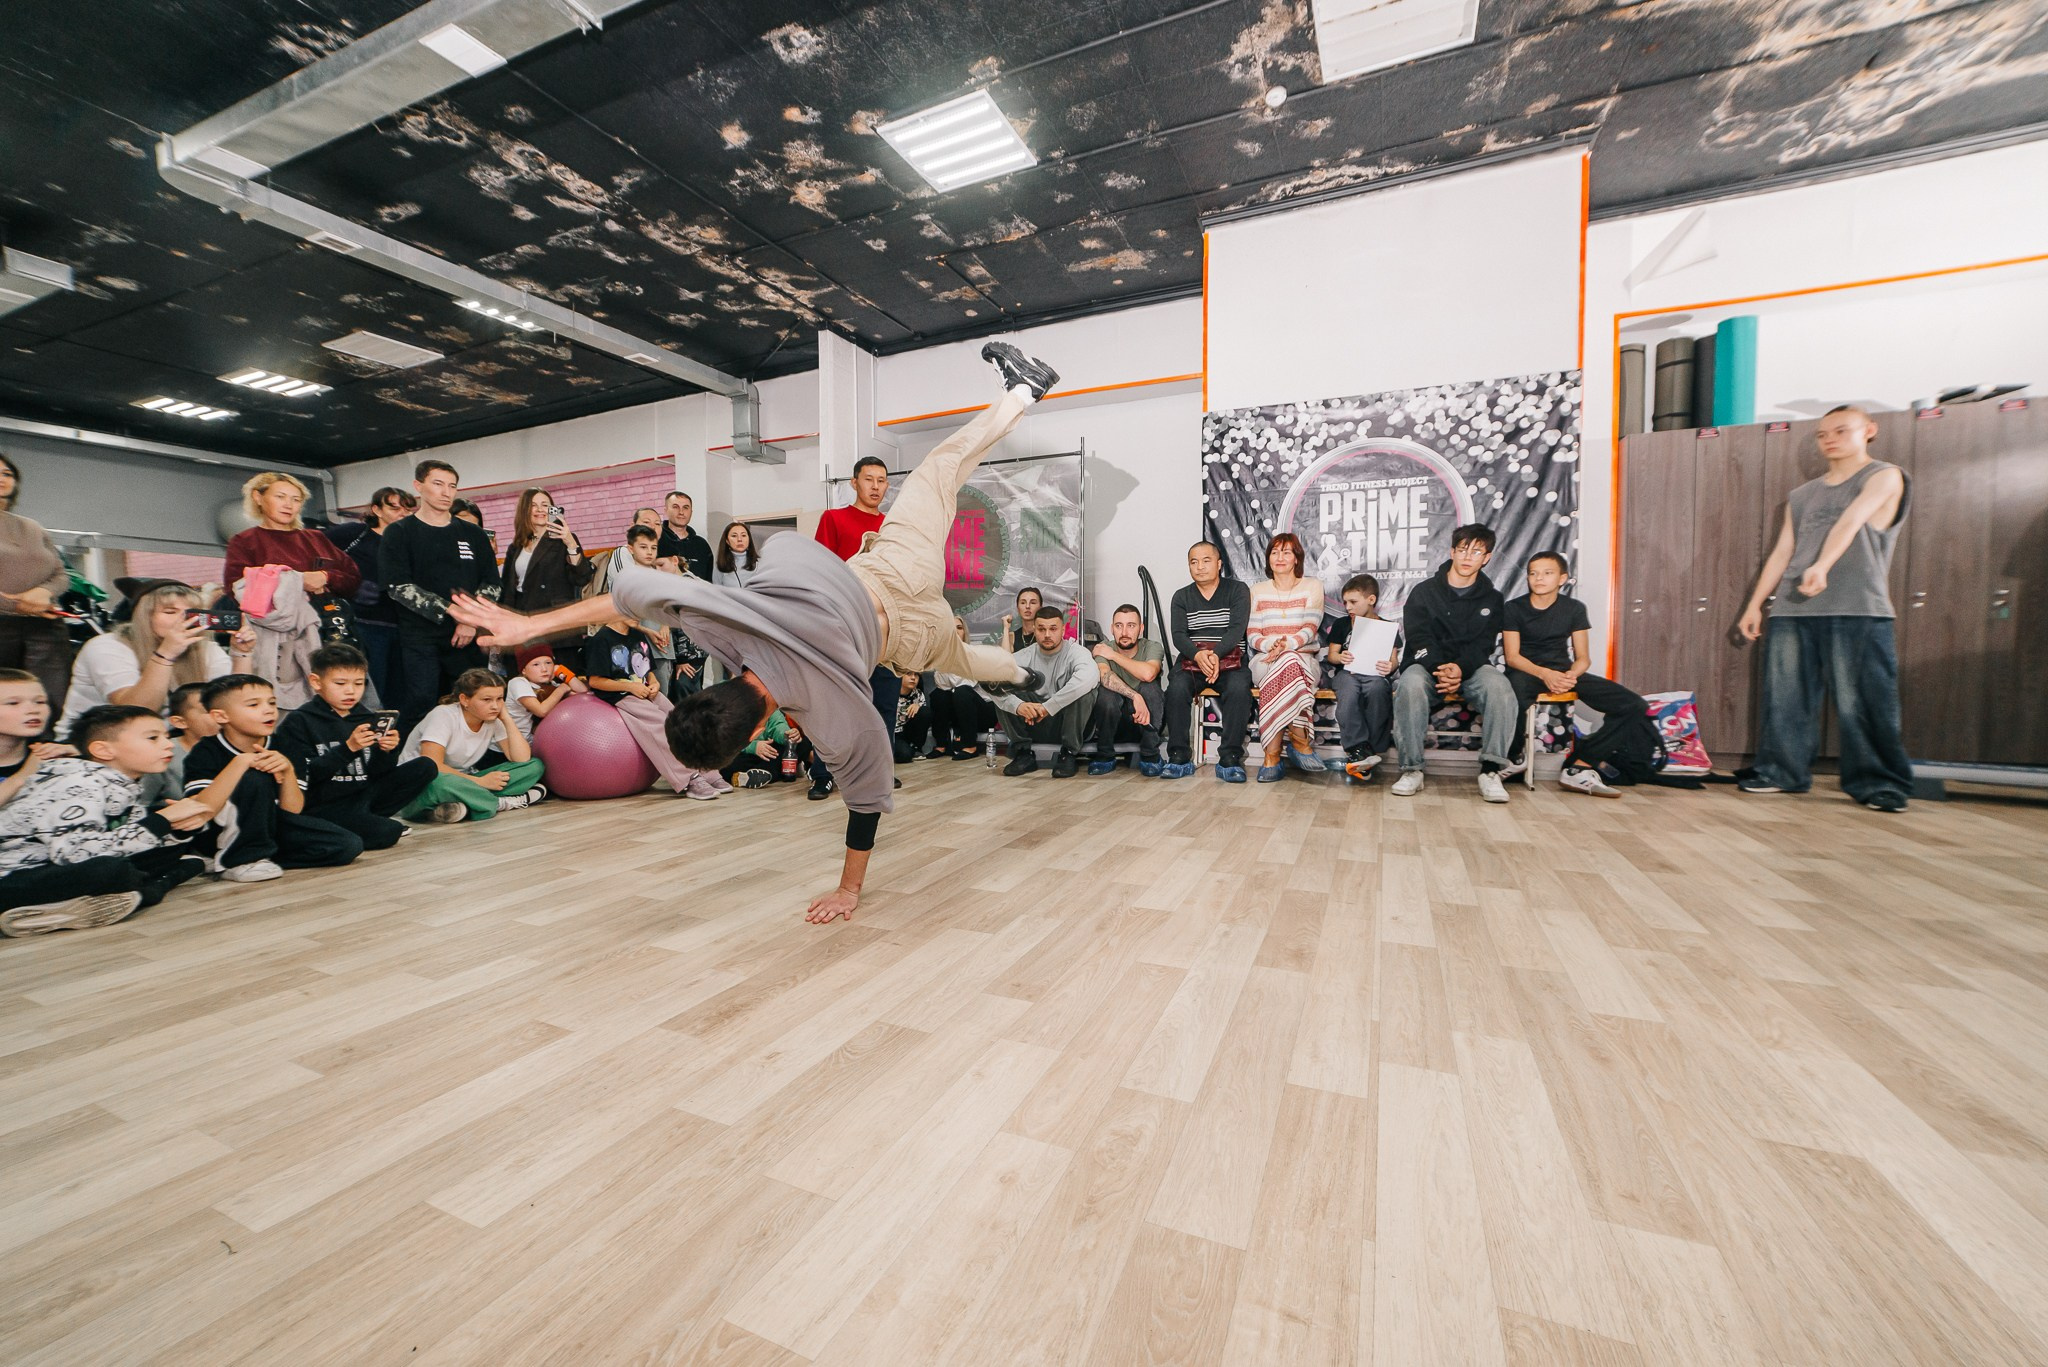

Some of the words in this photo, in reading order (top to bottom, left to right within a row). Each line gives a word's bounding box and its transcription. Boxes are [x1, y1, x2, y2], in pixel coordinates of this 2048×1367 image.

[1321, 483, 1349, 491] TREND
[1351, 480, 1386, 489] FITNESS
[1388, 476, 1429, 487] PROJECT
